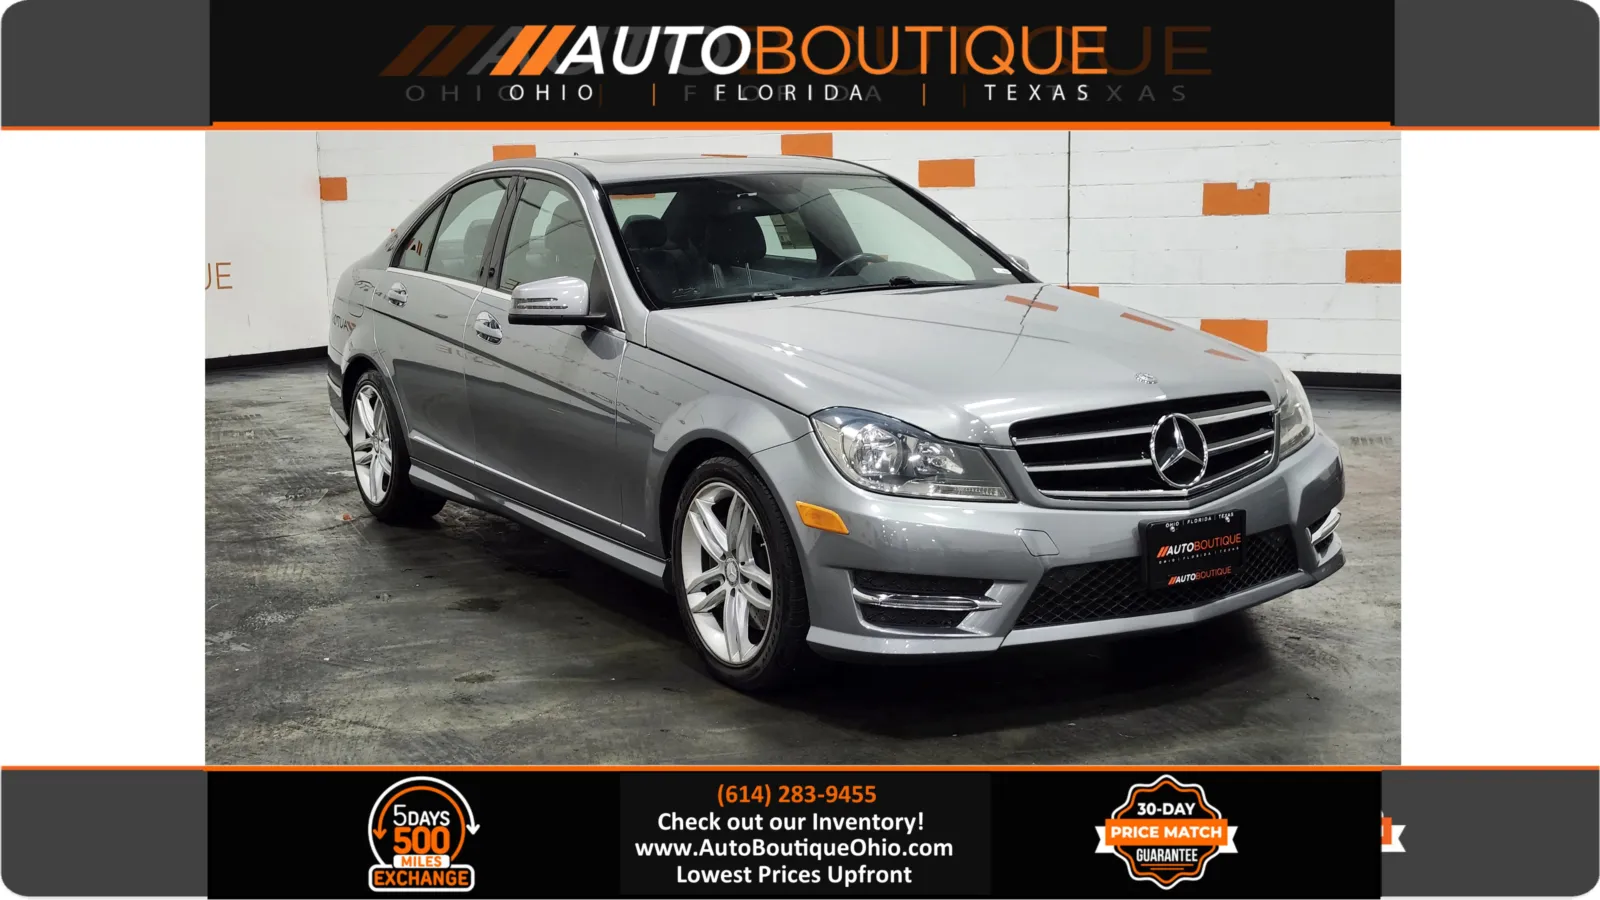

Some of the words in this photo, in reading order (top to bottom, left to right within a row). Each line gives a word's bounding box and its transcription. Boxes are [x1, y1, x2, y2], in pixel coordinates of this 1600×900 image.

[1187, 516, 1211, 524] FLORIDA
[1166, 533, 1241, 556] AUTOBOUTIQUE
[1175, 566, 1231, 583] AUTOBOUTIQUE
